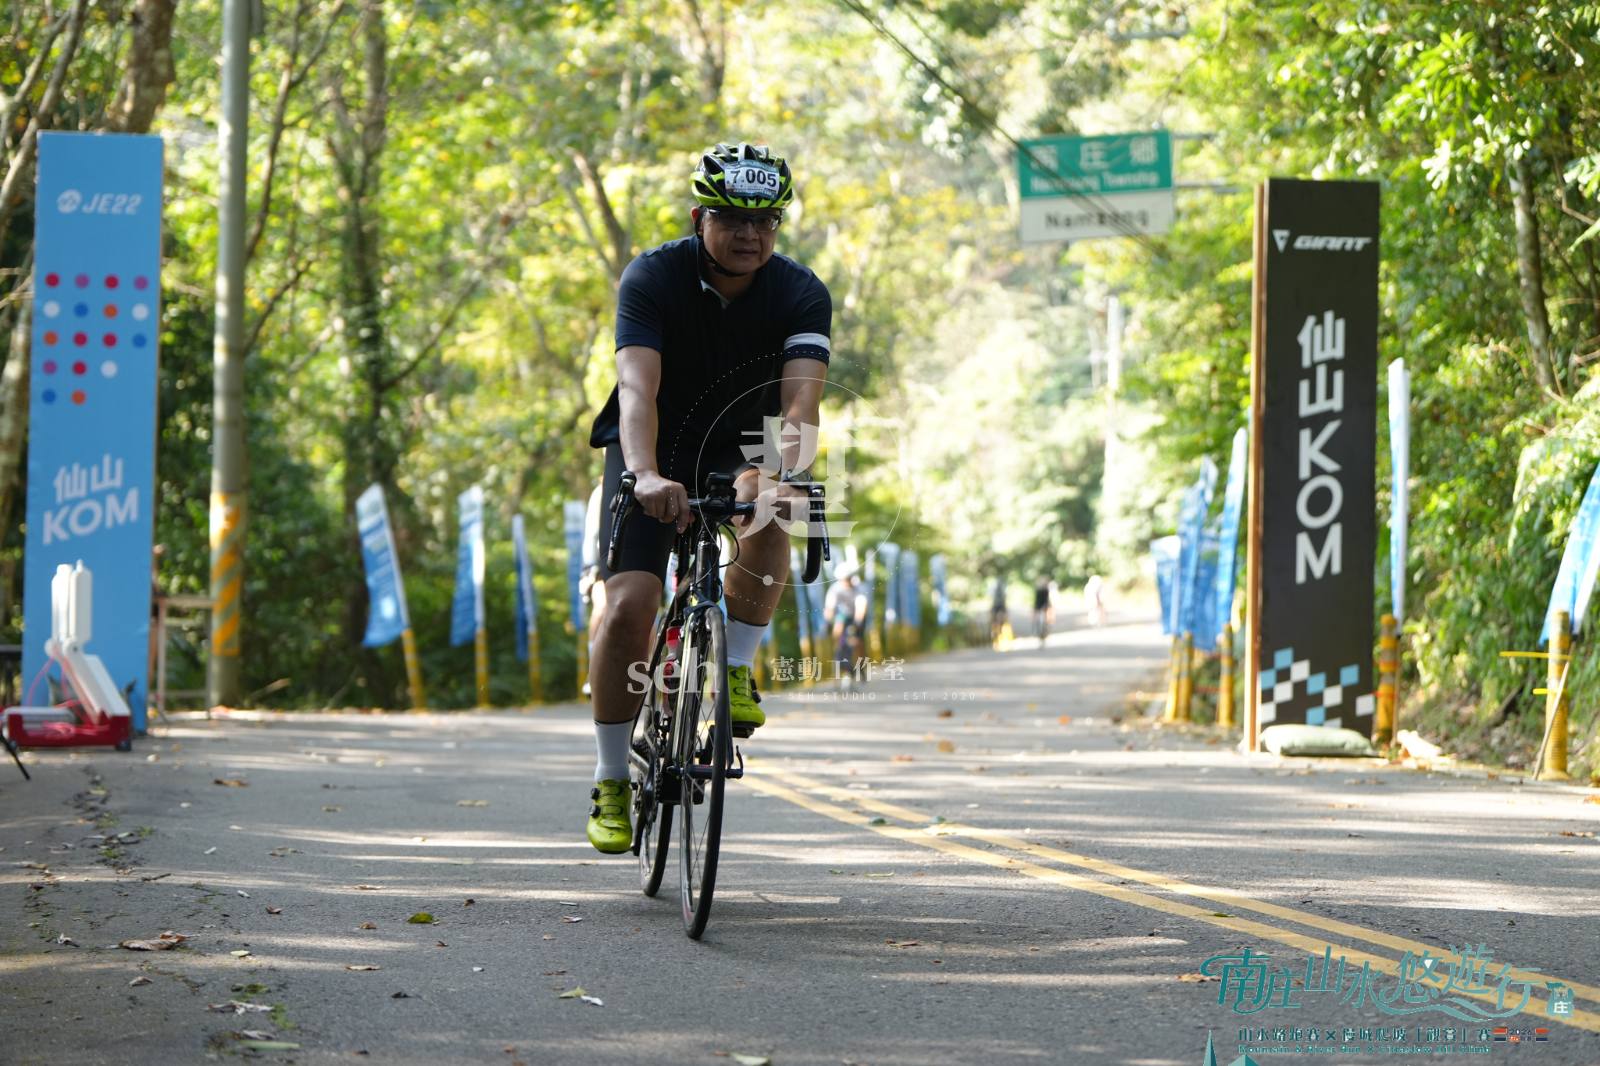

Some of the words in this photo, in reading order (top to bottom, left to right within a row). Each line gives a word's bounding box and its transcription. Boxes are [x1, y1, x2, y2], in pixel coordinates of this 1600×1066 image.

[82, 192, 142, 215] JE22
[1293, 234, 1372, 252] GIANT
[53, 453, 124, 501] 仙山
[42, 487, 139, 546] KOM
